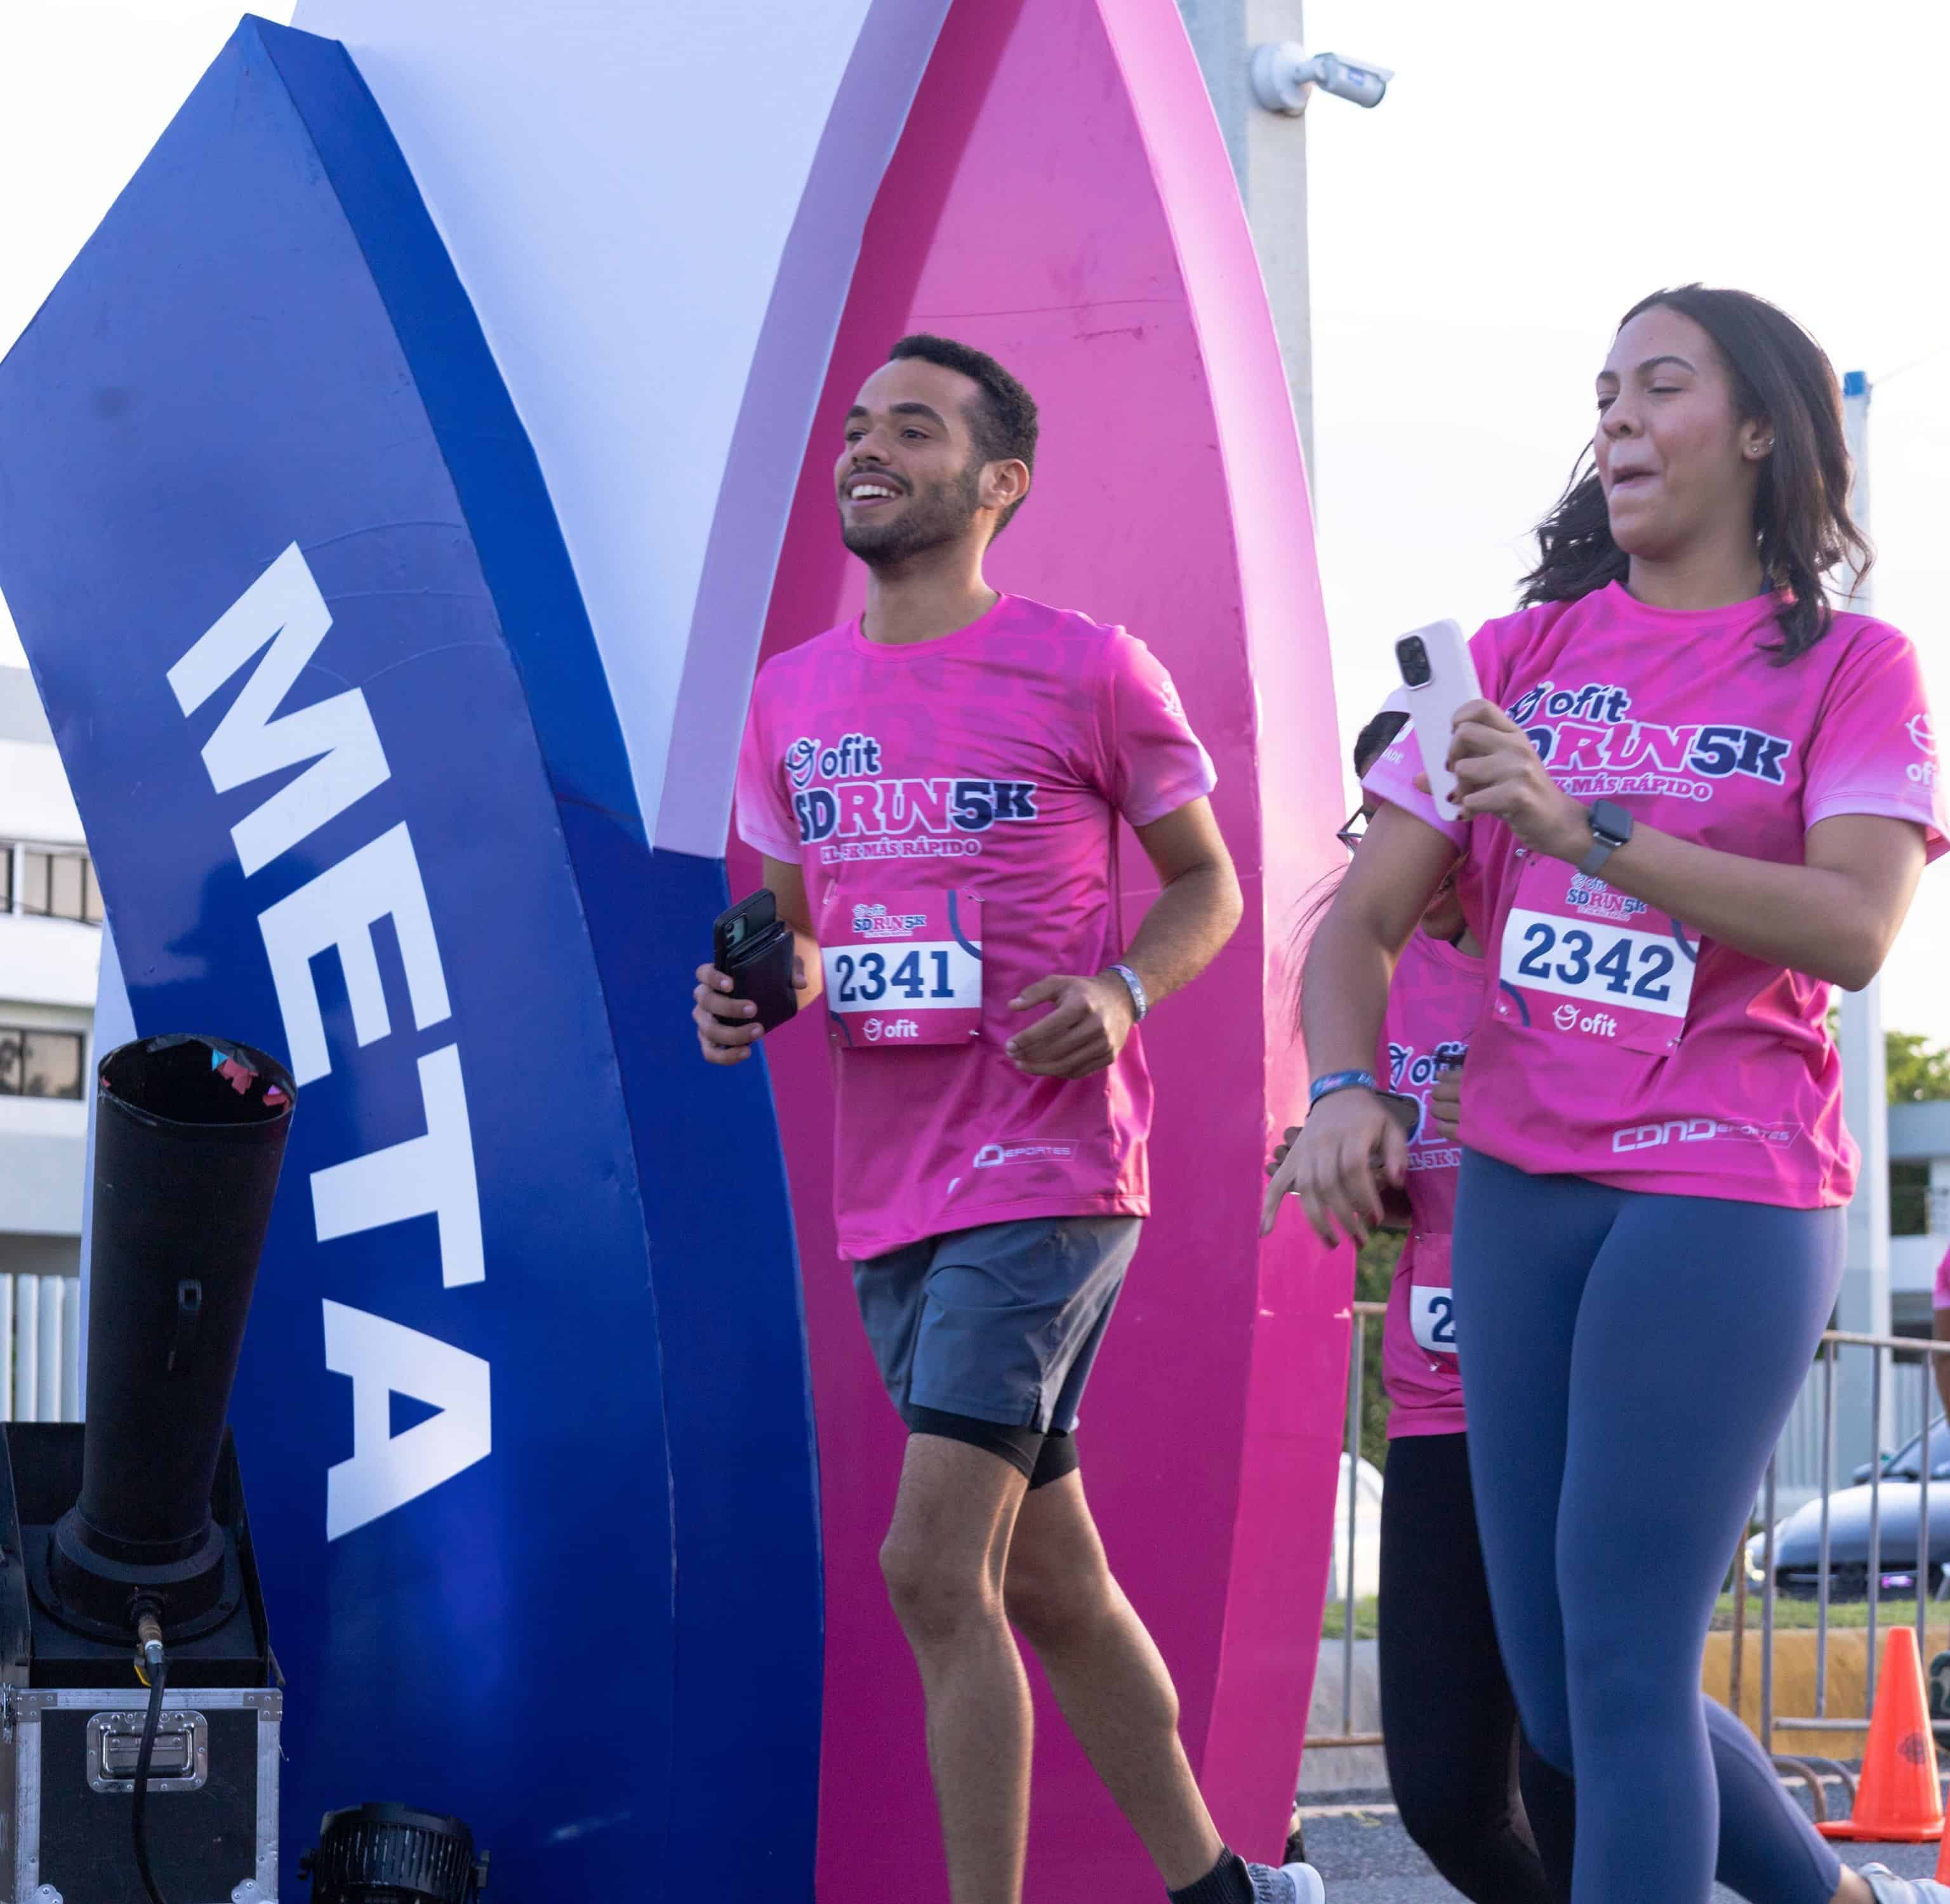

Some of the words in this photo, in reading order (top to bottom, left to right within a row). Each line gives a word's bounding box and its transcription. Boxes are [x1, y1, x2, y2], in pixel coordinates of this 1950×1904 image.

[1546, 683, 1631, 724] ofit
[820, 733, 882, 779] ofit
[1523, 720, 1793, 785] DRUN5K
[1569, 772, 1619, 795] MÁS
[1619, 772, 1713, 802] RÁPIDO
[861, 836, 899, 859] MÁS
[900, 835, 982, 857] RÁPIDO
[835, 950, 955, 1002] 2341
[1518, 922, 1675, 1002] 2342
[166, 540, 491, 1542] META
[884, 1019, 919, 1038] ofit
[1579, 1013, 1617, 1037] ofit
